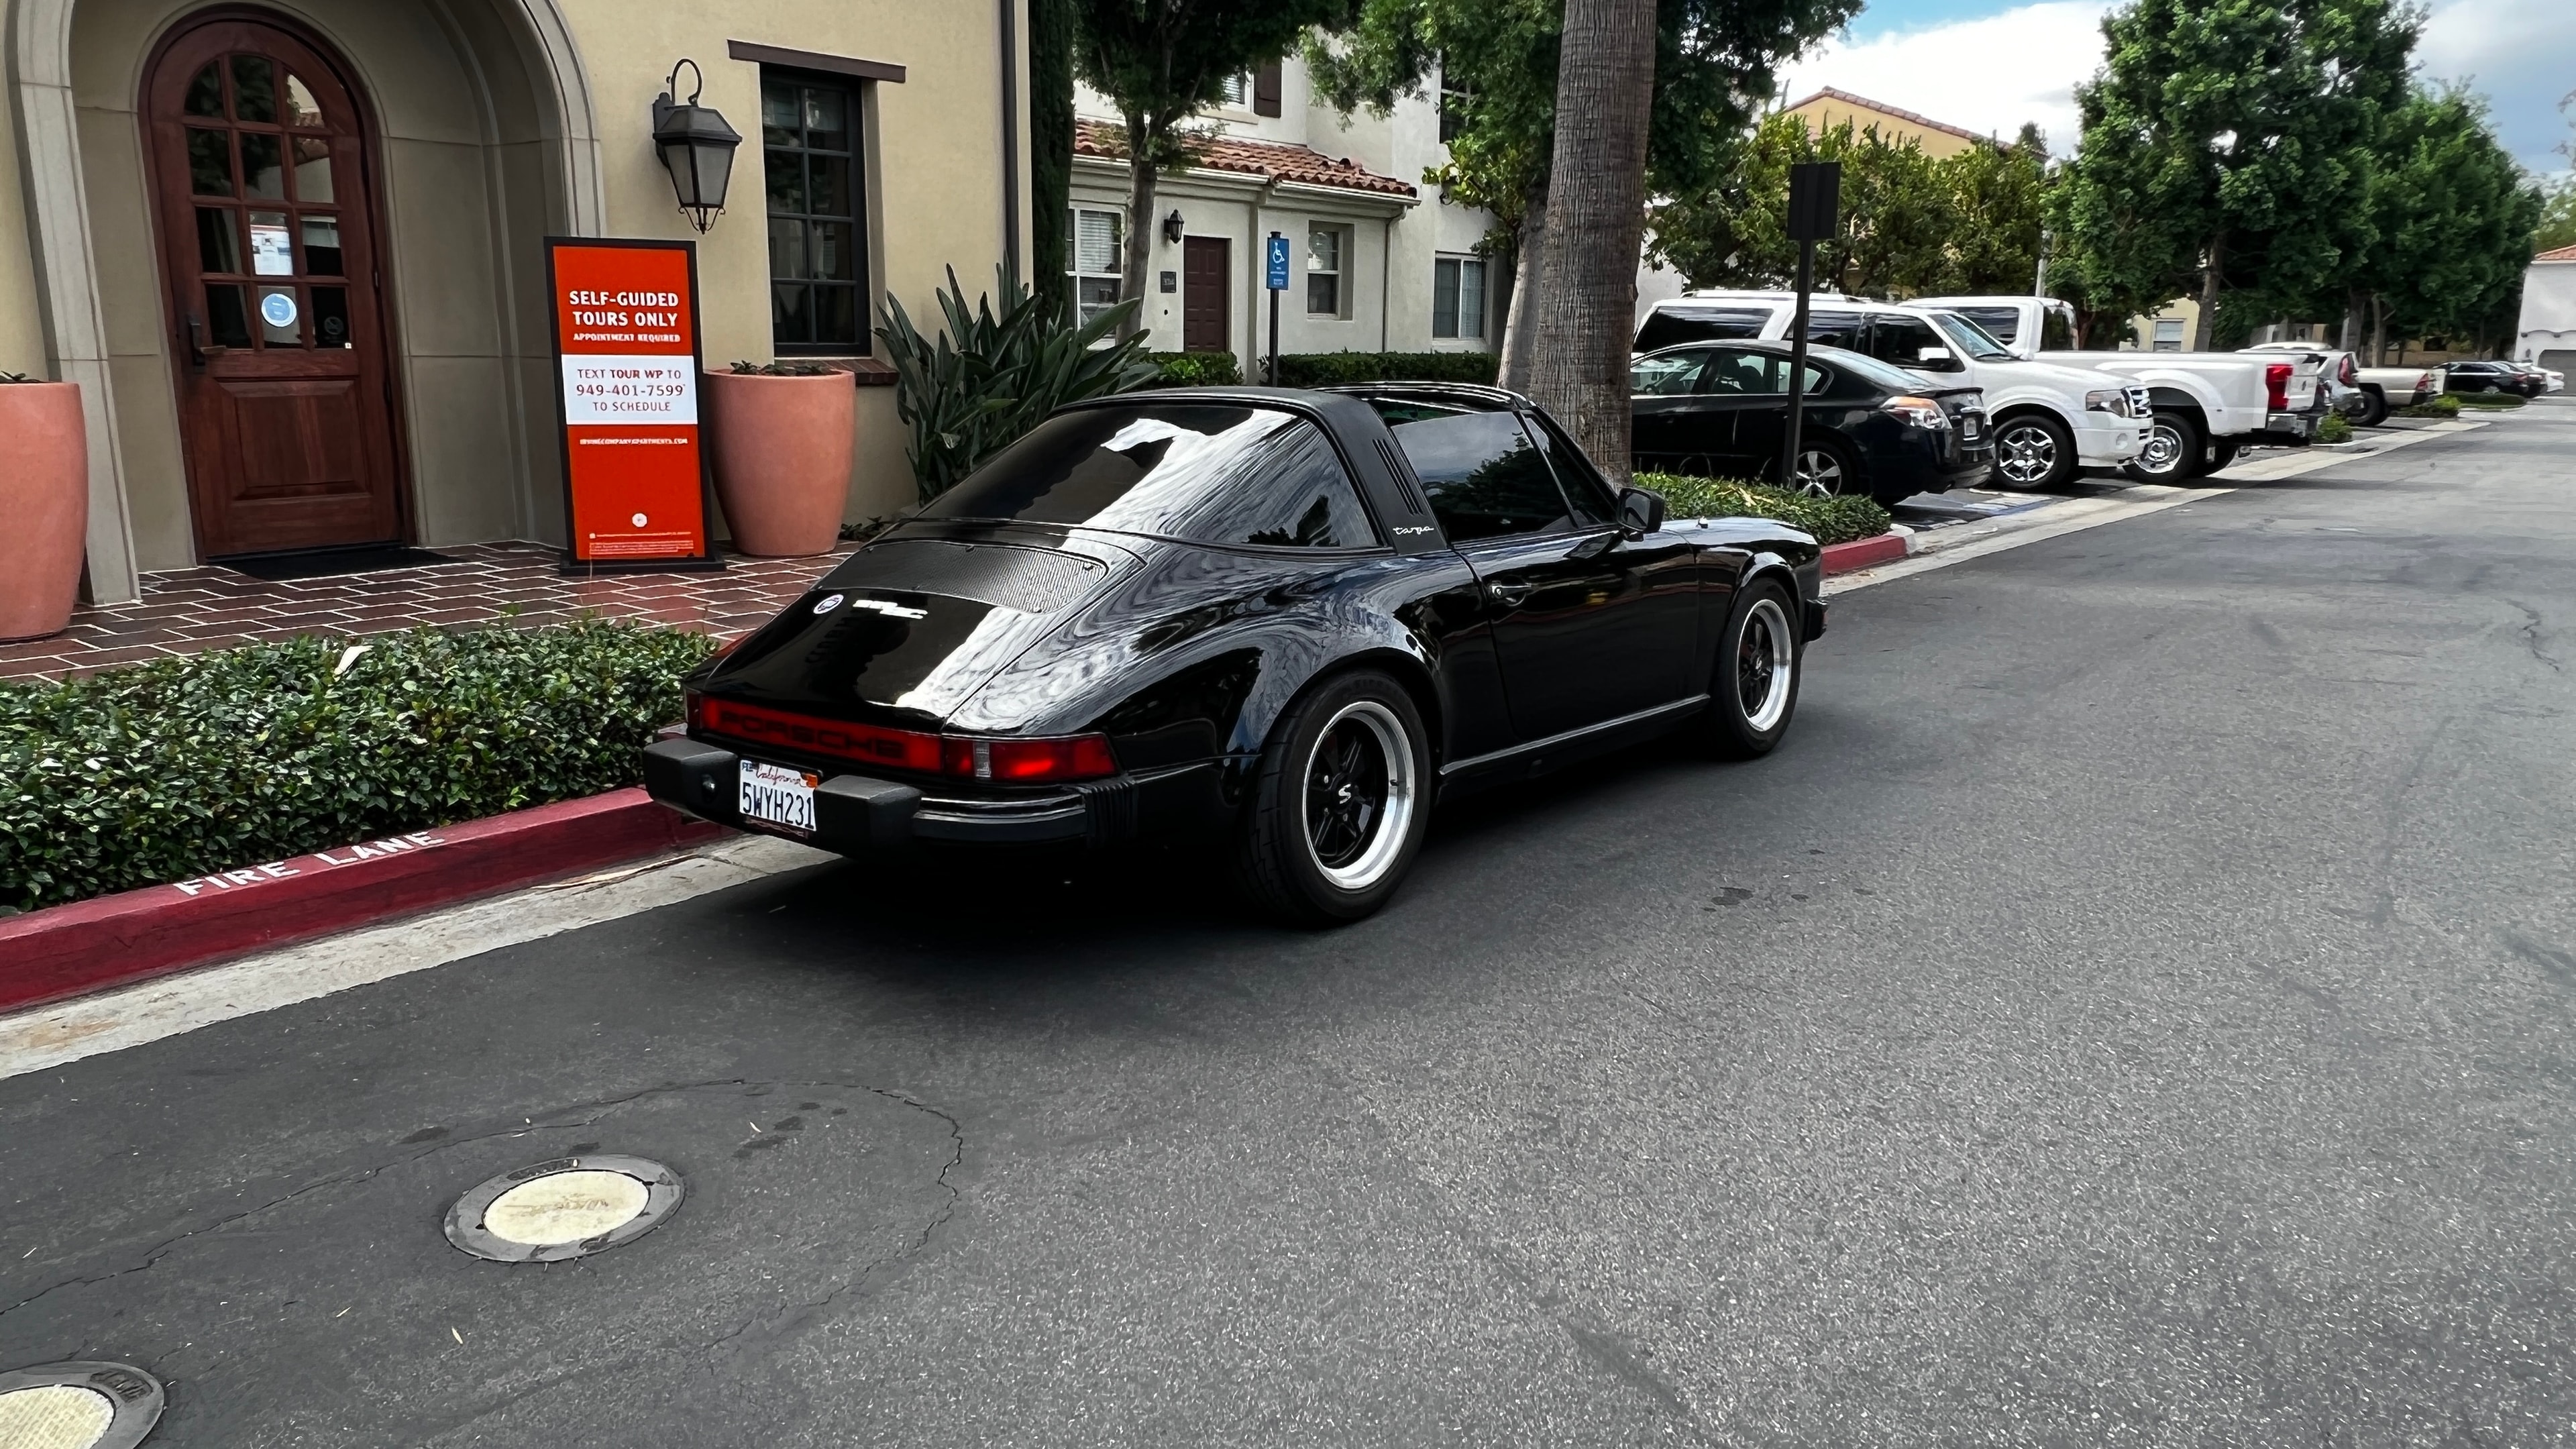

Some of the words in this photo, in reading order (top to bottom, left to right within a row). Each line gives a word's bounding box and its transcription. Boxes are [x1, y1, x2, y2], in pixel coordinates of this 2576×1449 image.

[570, 290, 679, 307] SELF-GUIDED
[572, 311, 629, 326] TOURS
[635, 312, 678, 327] ONLY
[574, 333, 634, 341] APPOINTMENT
[637, 334, 680, 343] REQUIRED
[578, 369, 605, 379] TEXT
[610, 370, 640, 379] TOUR
[644, 370, 663, 379] WP
[667, 370, 682, 379] TO
[593, 402, 608, 411] TO
[612, 402, 671, 411] SCHEDULE
[719, 711, 904, 759] PORSCHE
[743, 782, 814, 830] 5WYH231
[172, 861, 301, 896] FIRE
[314, 830, 445, 865] LANE
